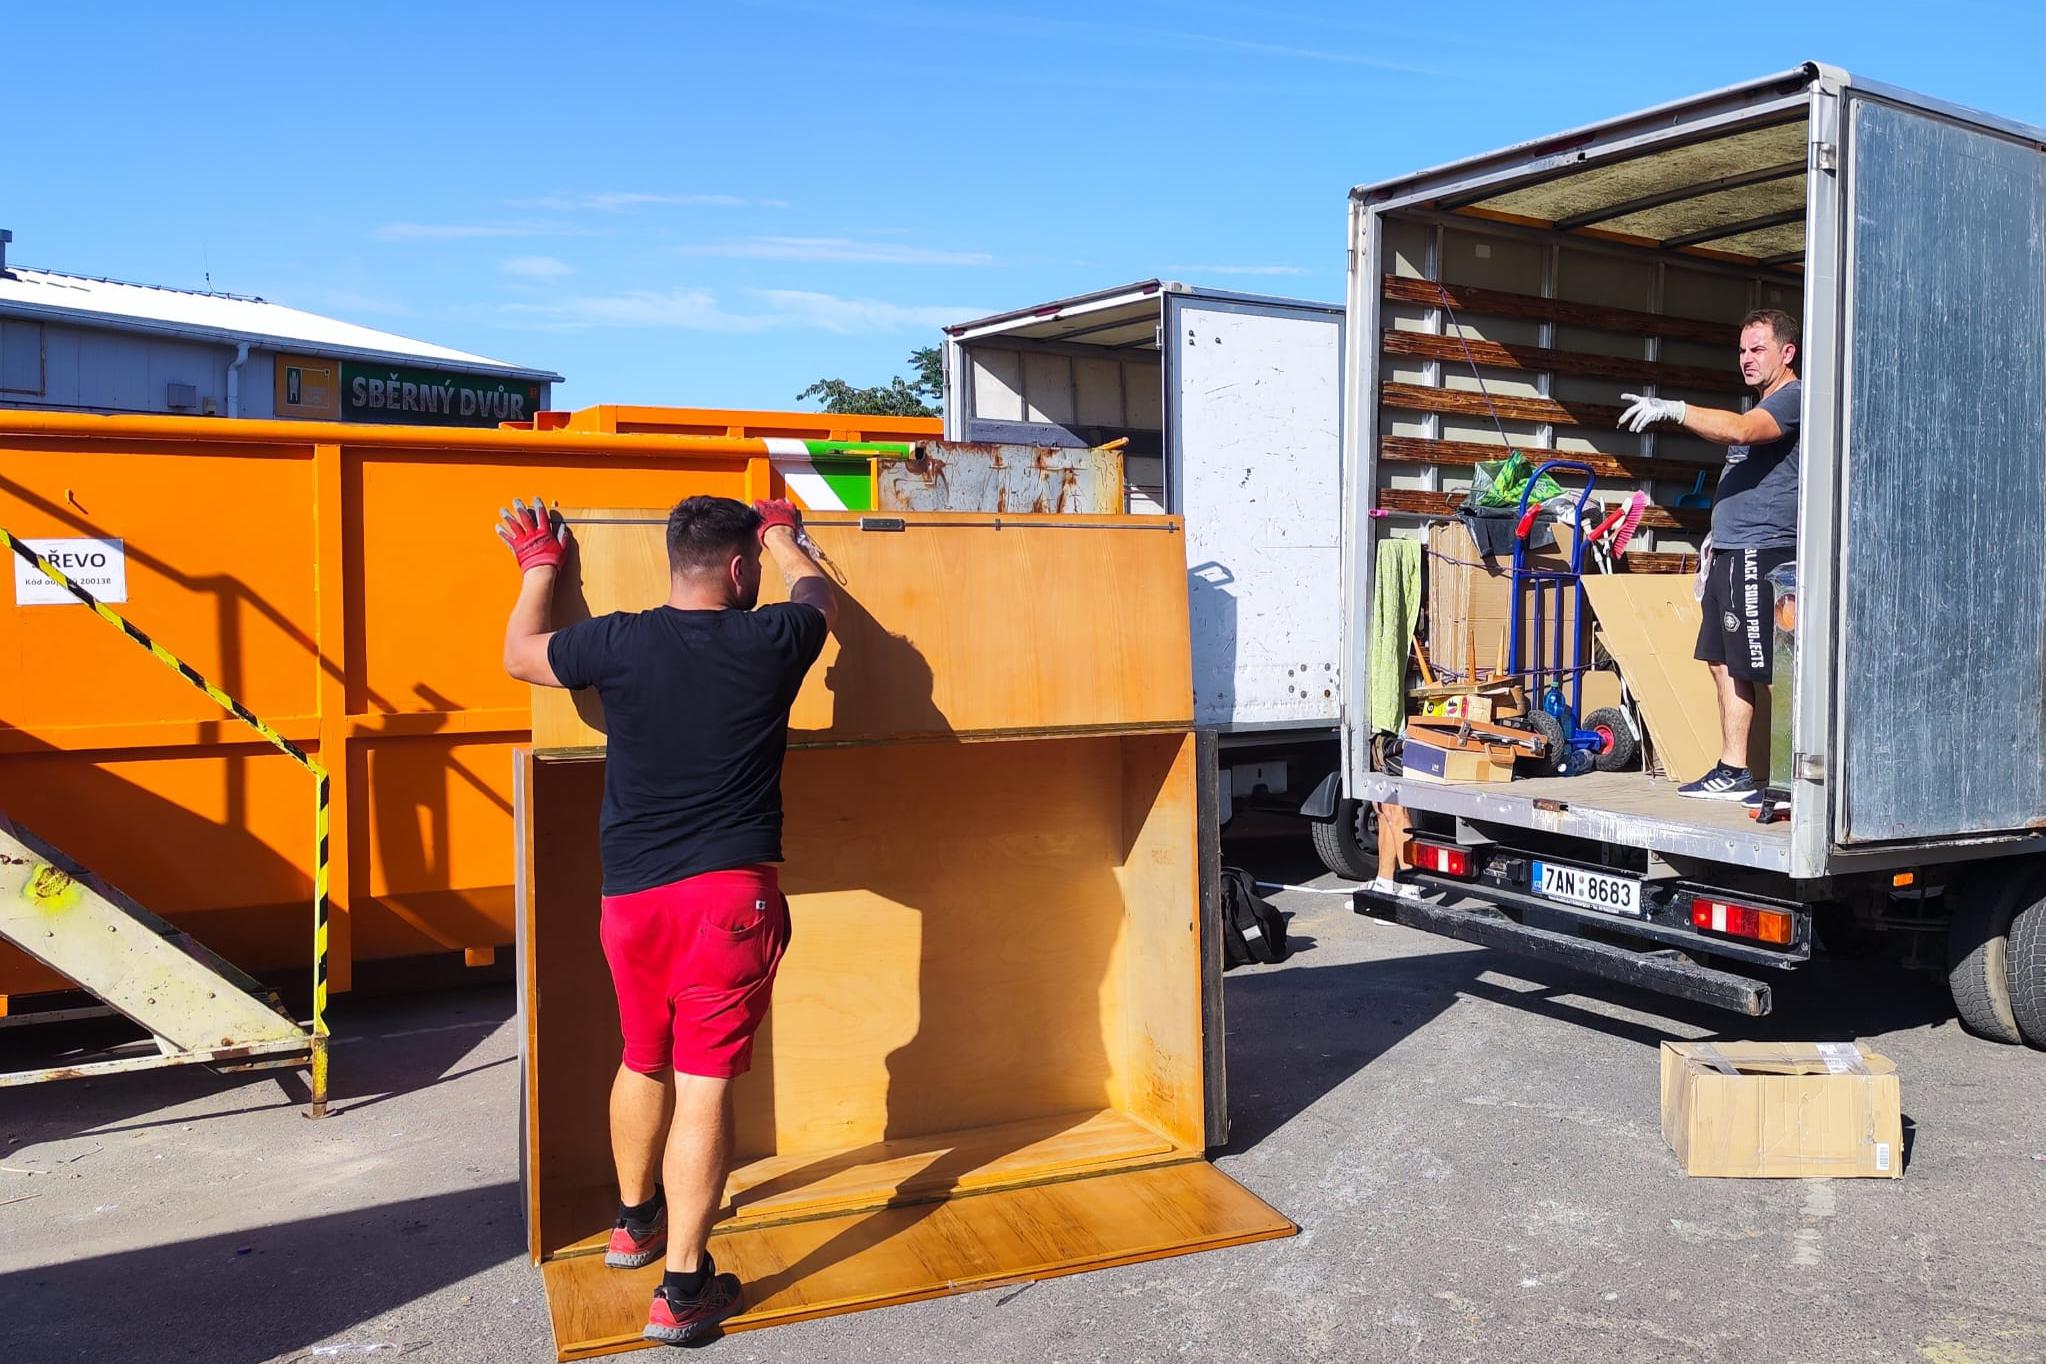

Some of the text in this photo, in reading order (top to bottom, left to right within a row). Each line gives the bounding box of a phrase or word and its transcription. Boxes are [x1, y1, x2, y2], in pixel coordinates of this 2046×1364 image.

[352, 373, 525, 419] SBĚRNÝ DVŮR
[1745, 584, 1759, 618] SQUAD
[1747, 620, 1765, 668] PROJECTS
[1545, 868, 1575, 895] 7AN
[1588, 877, 1631, 907] 8683
